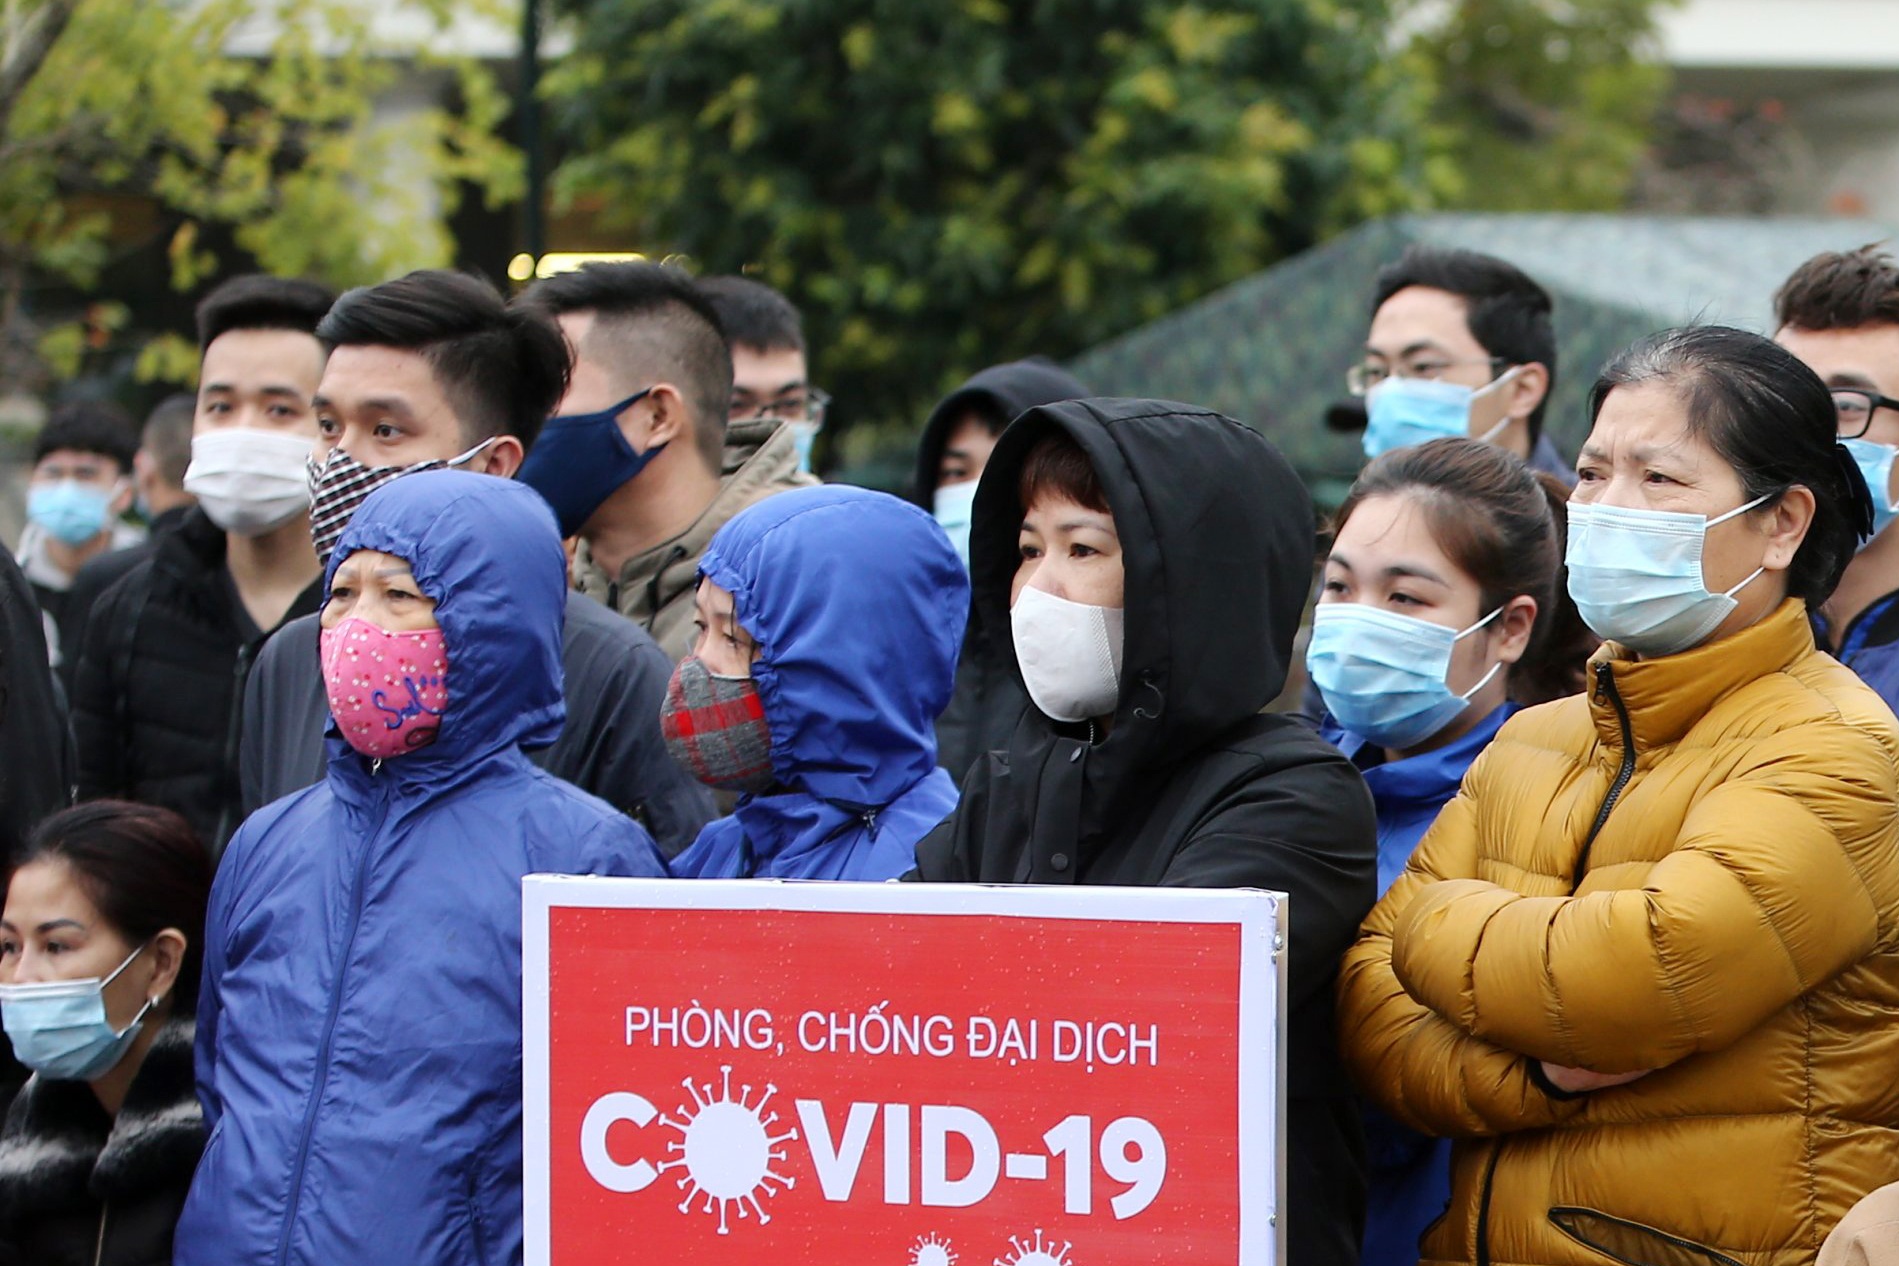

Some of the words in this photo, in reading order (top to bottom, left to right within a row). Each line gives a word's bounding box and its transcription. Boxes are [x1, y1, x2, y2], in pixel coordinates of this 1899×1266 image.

[625, 998, 785, 1057] PHÒNG,
[798, 1000, 955, 1057] CHỐNG
[965, 1016, 1038, 1068] ĐẠI
[1053, 1020, 1158, 1073] DỊCH
[580, 1070, 1168, 1230] COVID-19
